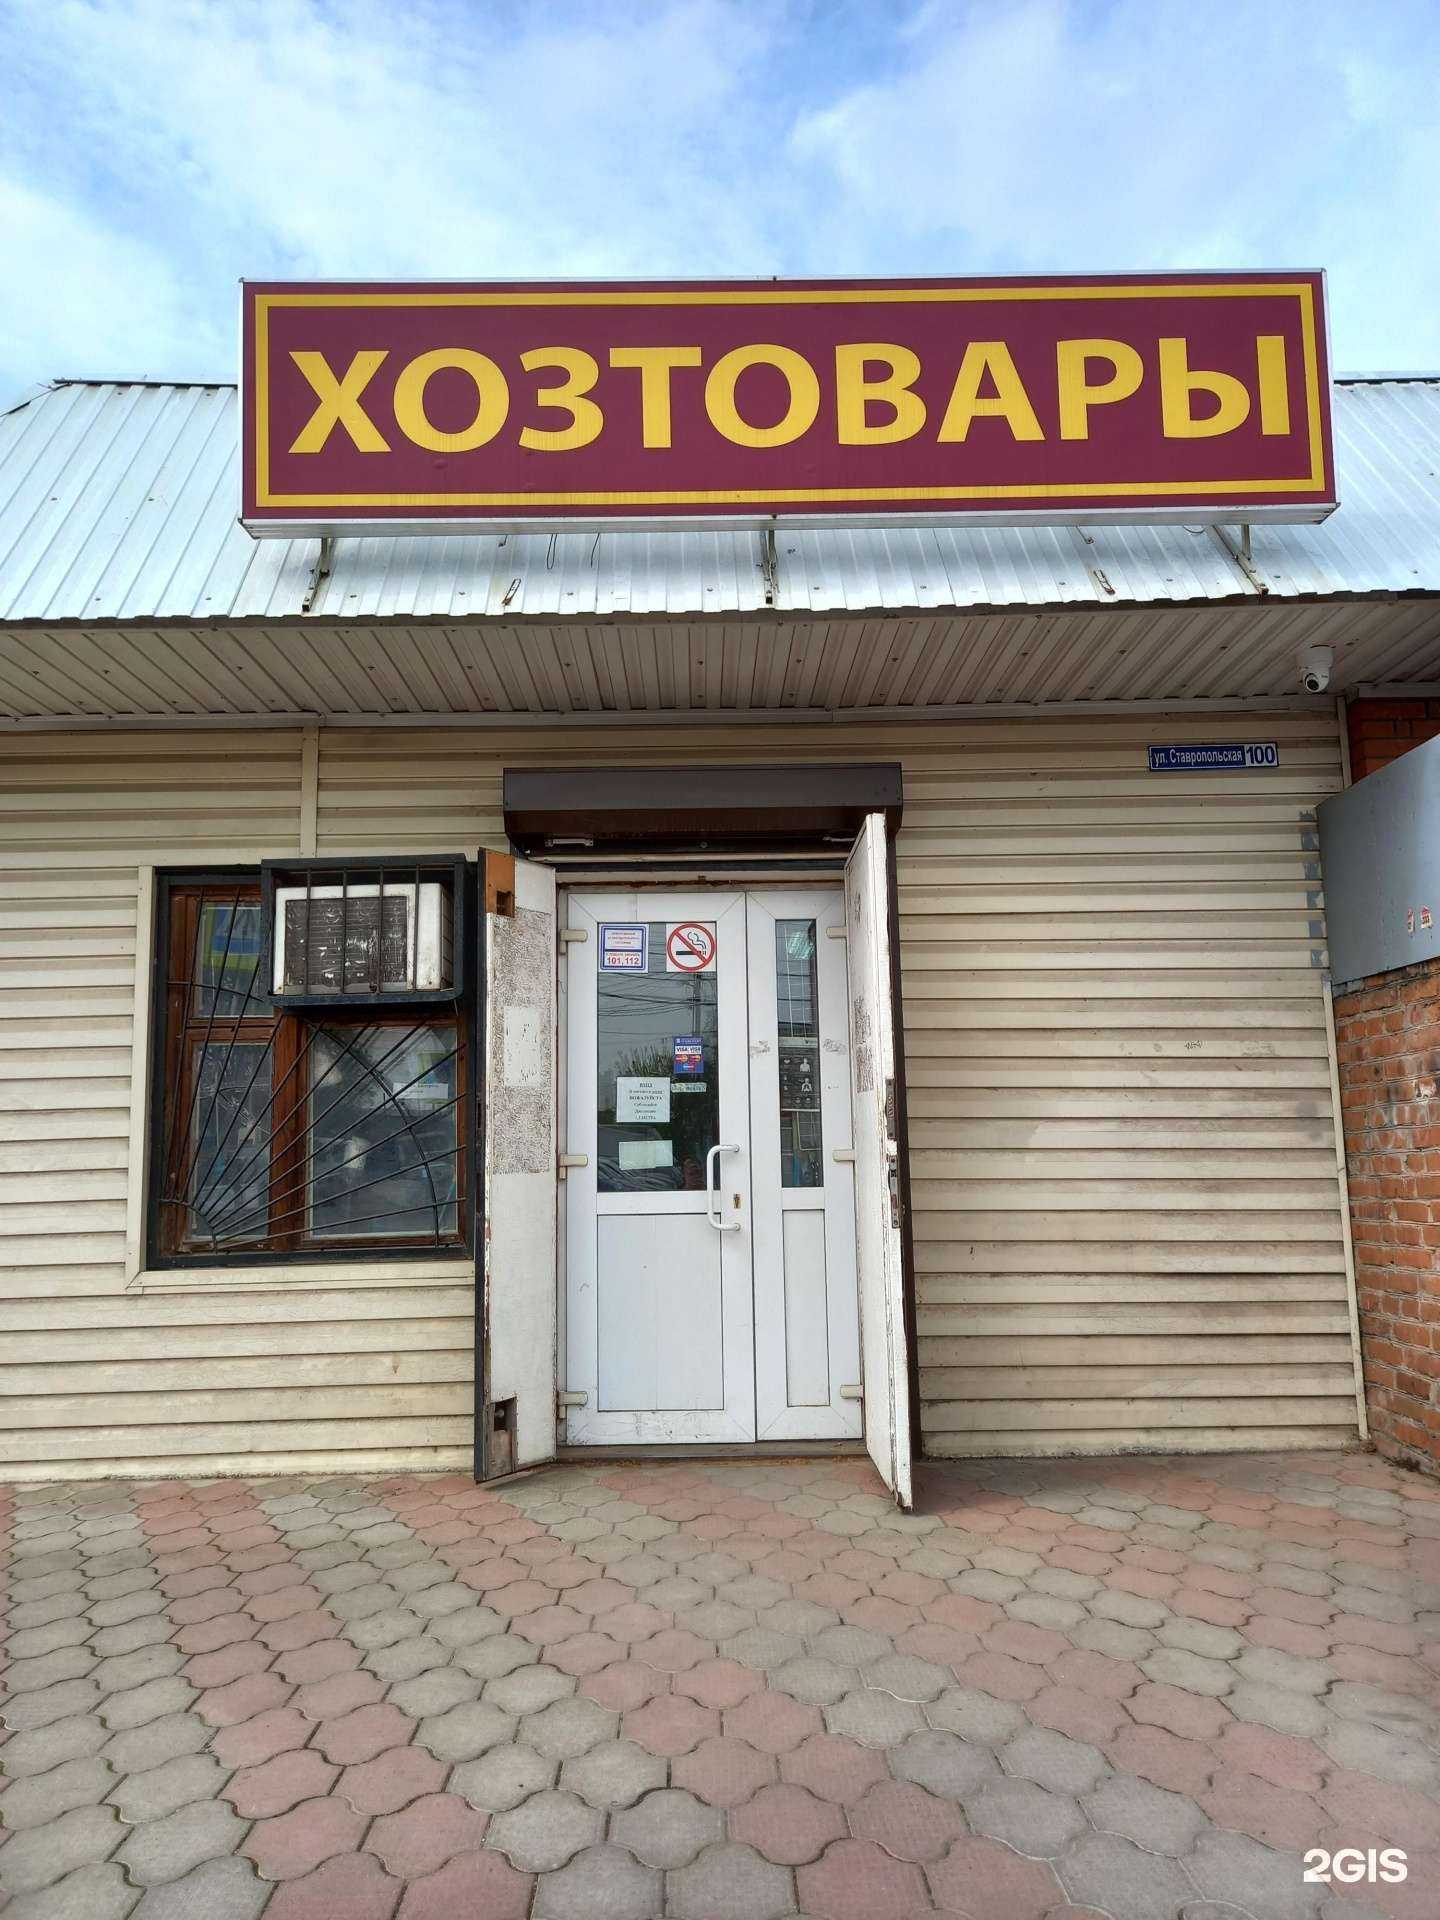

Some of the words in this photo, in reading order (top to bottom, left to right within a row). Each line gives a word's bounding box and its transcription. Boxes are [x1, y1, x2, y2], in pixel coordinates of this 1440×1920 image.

[288, 335, 1291, 454] ХОЗТОВАРЫ
[1154, 752, 1168, 767] ул.
[1169, 748, 1243, 766] Ставропольская
[1246, 745, 1275, 765] 100
